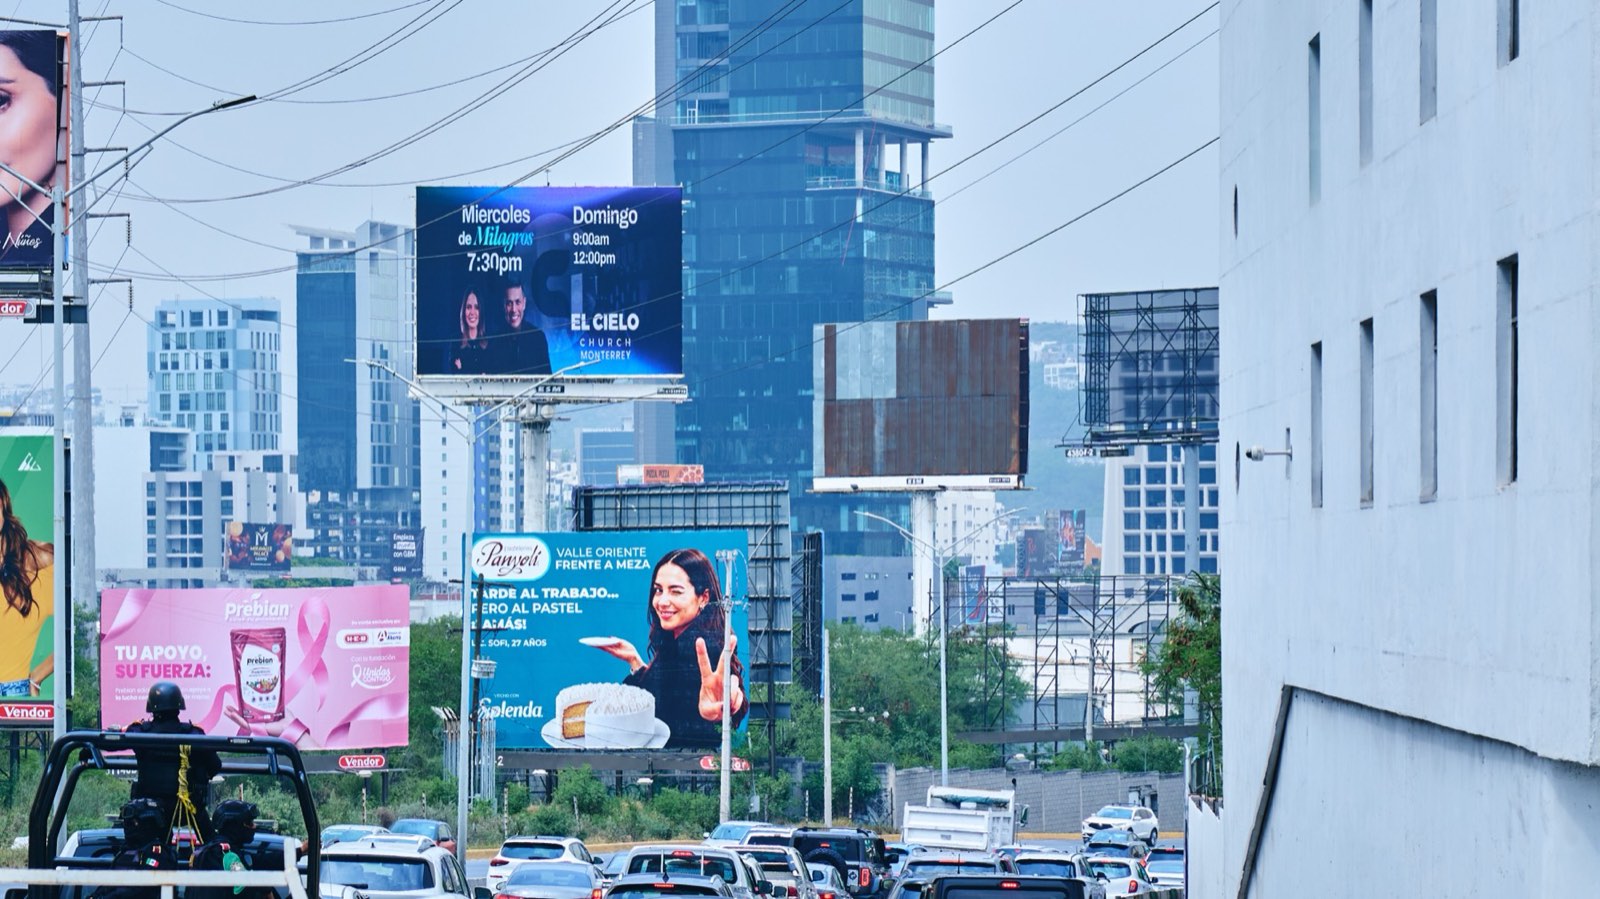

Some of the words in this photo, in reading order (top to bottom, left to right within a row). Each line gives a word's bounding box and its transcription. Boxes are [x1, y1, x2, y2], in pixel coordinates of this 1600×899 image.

[462, 205, 530, 223] Miercoles
[573, 205, 638, 229] Domingo
[458, 231, 472, 245] de
[473, 225, 534, 253] Milagros
[573, 233, 609, 246] 9:00am
[467, 252, 522, 276] 7:30pm
[573, 251, 616, 267] 12:00pm
[571, 313, 590, 331] EL
[592, 313, 640, 331] CIELO
[579, 338, 631, 347] CHURCH
[580, 350, 631, 360] MONTERREY
[556, 548, 593, 558] VALLE
[595, 547, 647, 558] ORIENTE
[555, 560, 601, 570] FRENTE
[604, 560, 614, 569] A
[616, 559, 651, 569] MEZA
[520, 588, 539, 599] AL
[541, 587, 619, 599] TRABAJO...
[511, 603, 529, 614] AL
[532, 602, 583, 614] PASTEL
[511, 639, 521, 647] 27
[523, 637, 547, 647] AÑOS
[115, 646, 137, 660] TU
[140, 645, 207, 662] APOYO,
[115, 664, 137, 678] SU
[141, 664, 211, 678] FUERZA:
[4, 706, 51, 718] Vendor
[344, 757, 380, 767] Vendor
